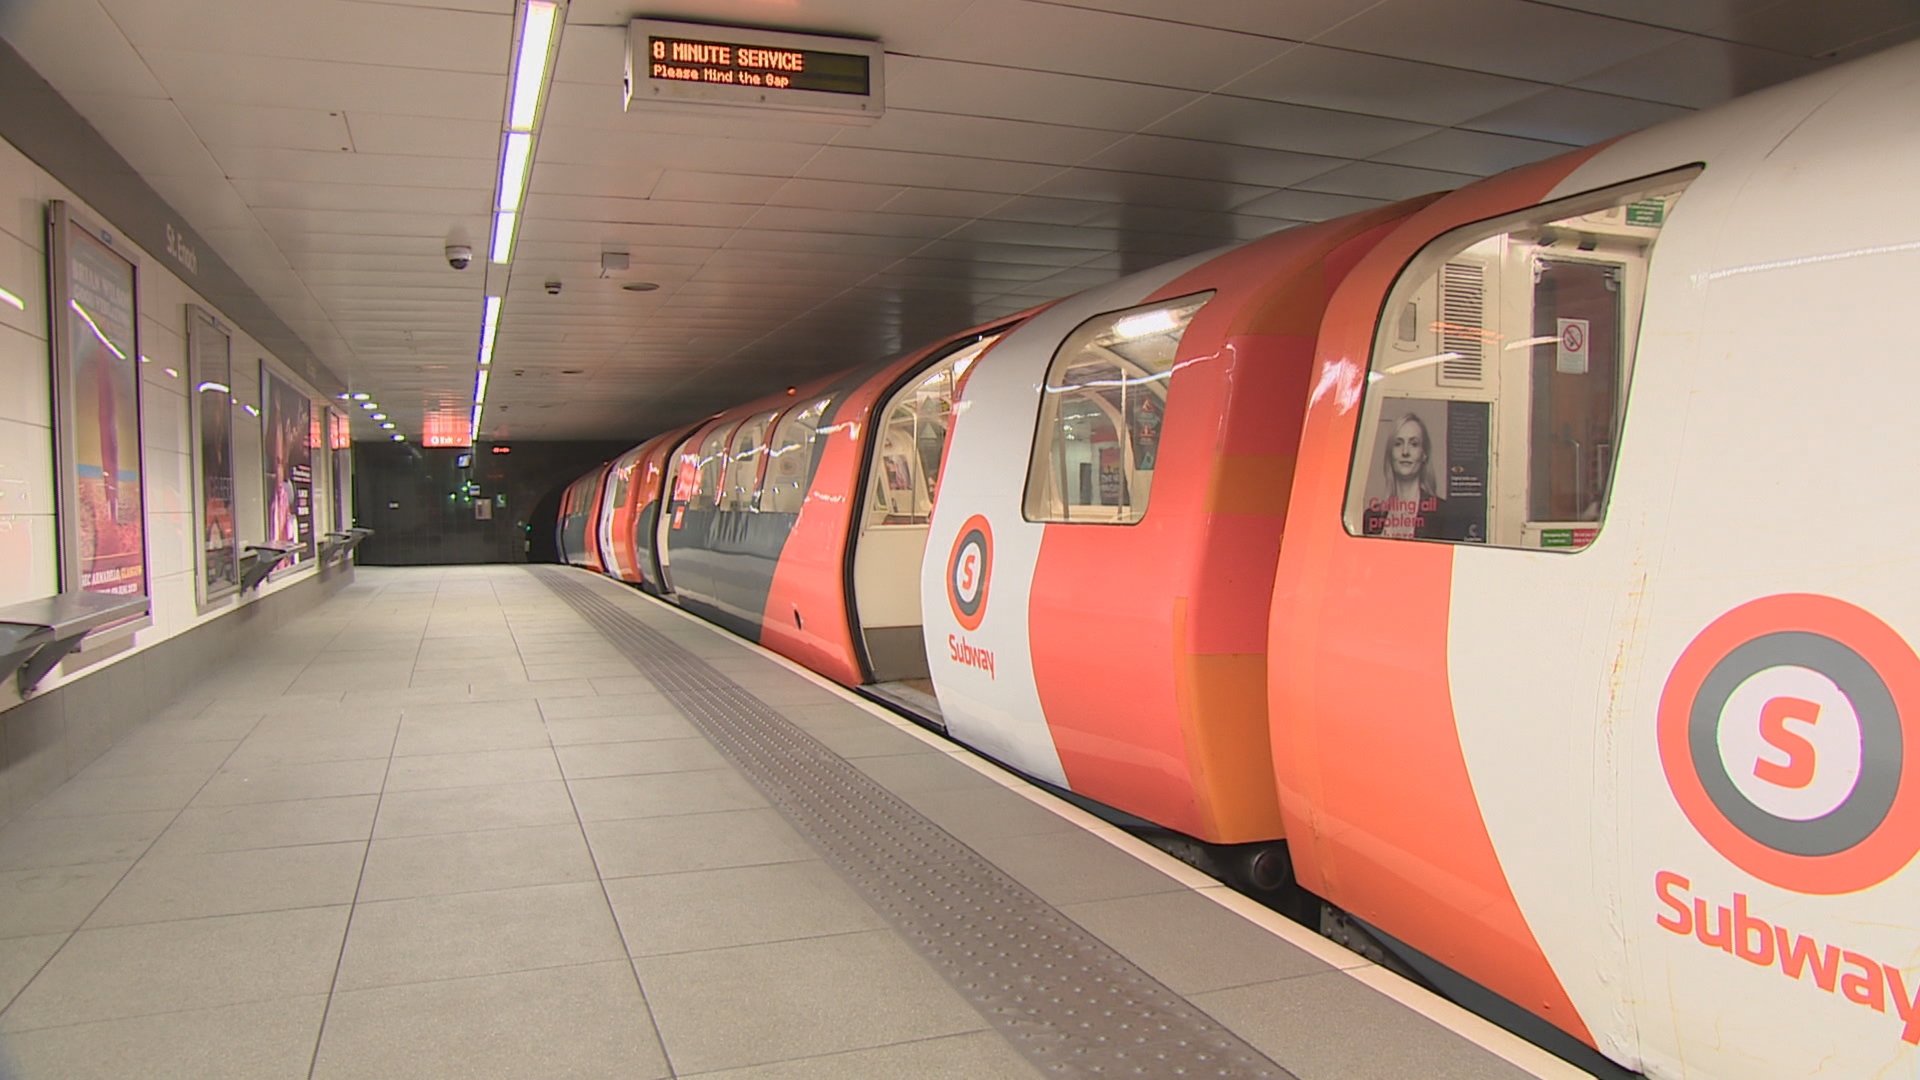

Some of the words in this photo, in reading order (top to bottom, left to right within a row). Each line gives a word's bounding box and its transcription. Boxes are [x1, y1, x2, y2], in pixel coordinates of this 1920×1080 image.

[653, 41, 666, 60] 8
[672, 42, 731, 65] MINUTE
[737, 48, 804, 72] SERVICE
[653, 64, 699, 80] Please
[704, 68, 733, 83] Mind
[738, 71, 761, 86] the
[766, 73, 790, 89] Gap
[1369, 496, 1417, 515] Calling
[1421, 496, 1438, 512] all
[1368, 514, 1425, 531] problem
[948, 633, 995, 681] Subway
[1752, 695, 1822, 790] S
[1655, 870, 1920, 1046] Subway
